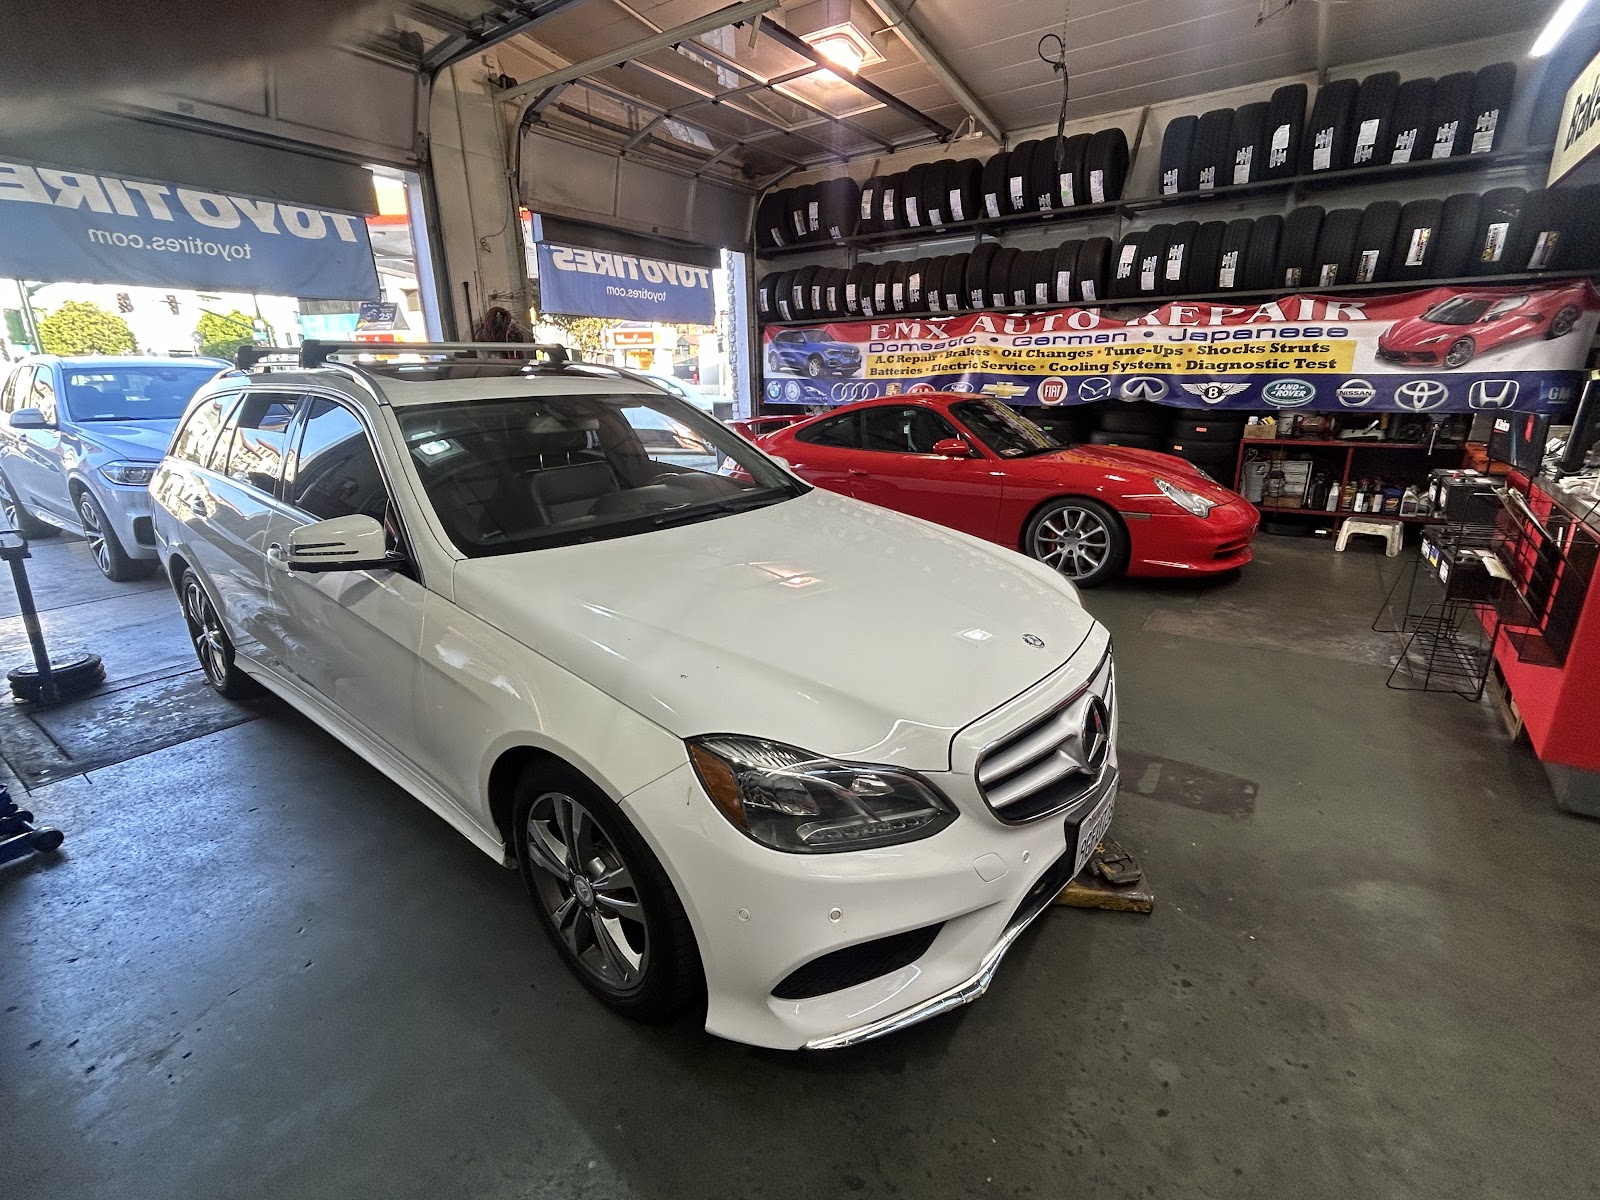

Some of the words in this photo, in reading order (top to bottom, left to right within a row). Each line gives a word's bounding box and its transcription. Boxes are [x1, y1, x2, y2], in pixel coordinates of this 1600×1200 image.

[870, 322, 950, 341] EMX
[969, 311, 1100, 335] AUTO
[869, 336, 977, 353] Domestic
[1012, 332, 1128, 347] German
[1168, 327, 1348, 343] Japanese
[875, 355, 894, 364] A.C
[896, 354, 937, 365] Repair
[945, 348, 990, 361] Brakes
[1002, 350, 1022, 358] Oil
[1026, 349, 1093, 360] Changes
[1105, 345, 1183, 357] Tune-Ups
[1197, 343, 1265, 355] Shocks
[1270, 343, 1330, 353] Struts
[870, 368, 922, 376] Batteries
[931, 361, 978, 372] Electric
[981, 361, 1036, 371] Service
[1049, 362, 1109, 373] Cooling
[1113, 360, 1172, 372] System
[1186, 359, 1290, 372] Diagnostic
[1294, 359, 1337, 369] Test
[1045, 385, 1061, 398] FIAT
